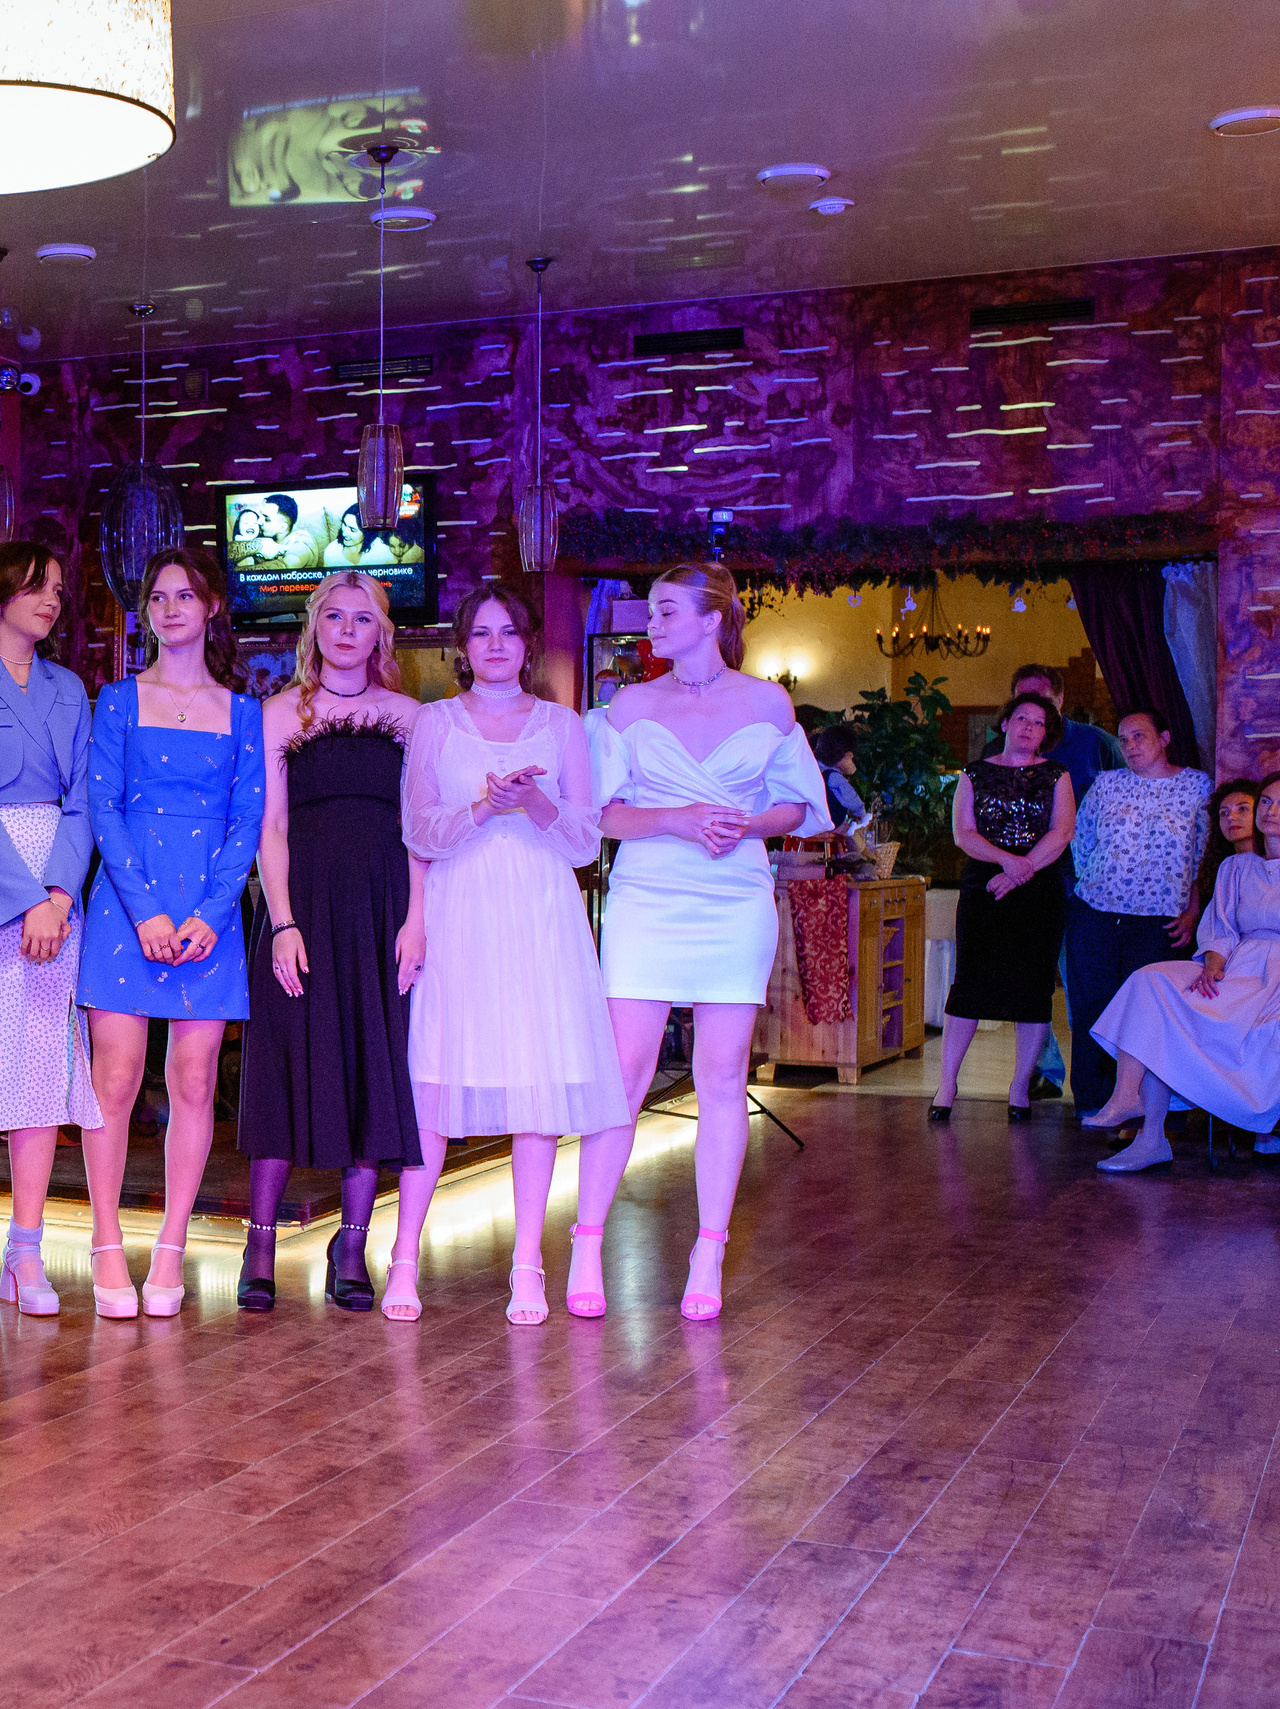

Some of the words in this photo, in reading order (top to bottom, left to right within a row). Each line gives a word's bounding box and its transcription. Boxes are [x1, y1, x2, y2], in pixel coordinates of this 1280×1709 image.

[239, 573, 245, 583] В
[246, 574, 280, 582] каждом
[281, 570, 325, 582] наброске,
[367, 567, 413, 578] черновике
[259, 584, 277, 593] Мир
